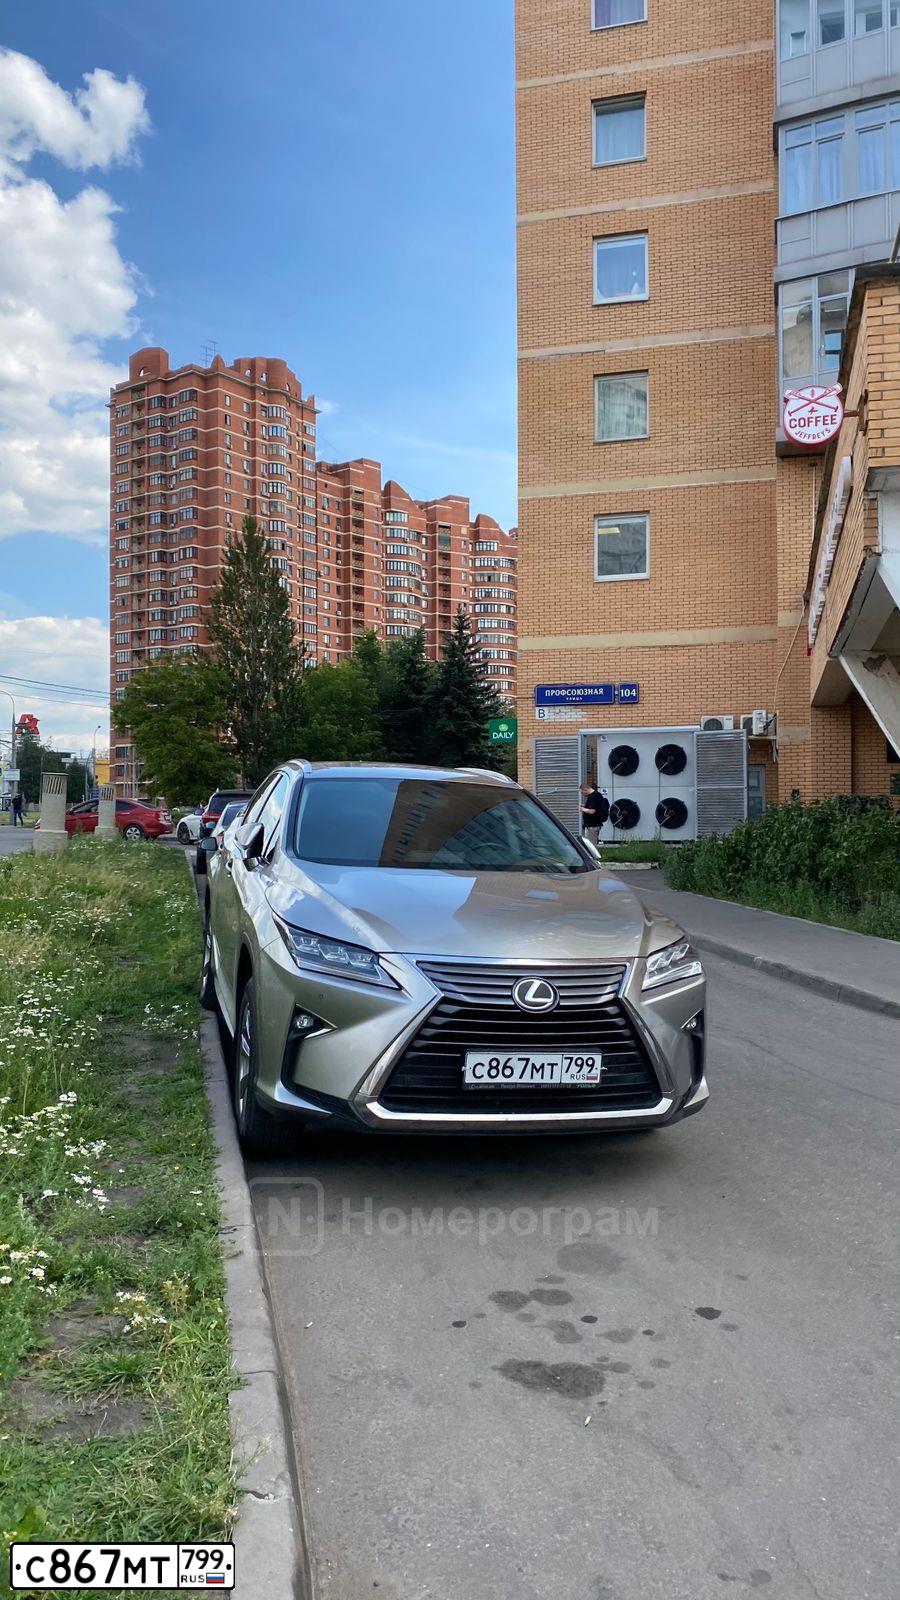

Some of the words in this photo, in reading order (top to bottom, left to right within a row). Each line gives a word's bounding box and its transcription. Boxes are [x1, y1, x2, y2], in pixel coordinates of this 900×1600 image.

[789, 414, 837, 429] COFFEE
[545, 688, 604, 697] ПРОФСОЮЗНАЯ
[620, 688, 637, 697] 104
[492, 731, 514, 739] DAILY
[563, 1056, 596, 1074] 799
